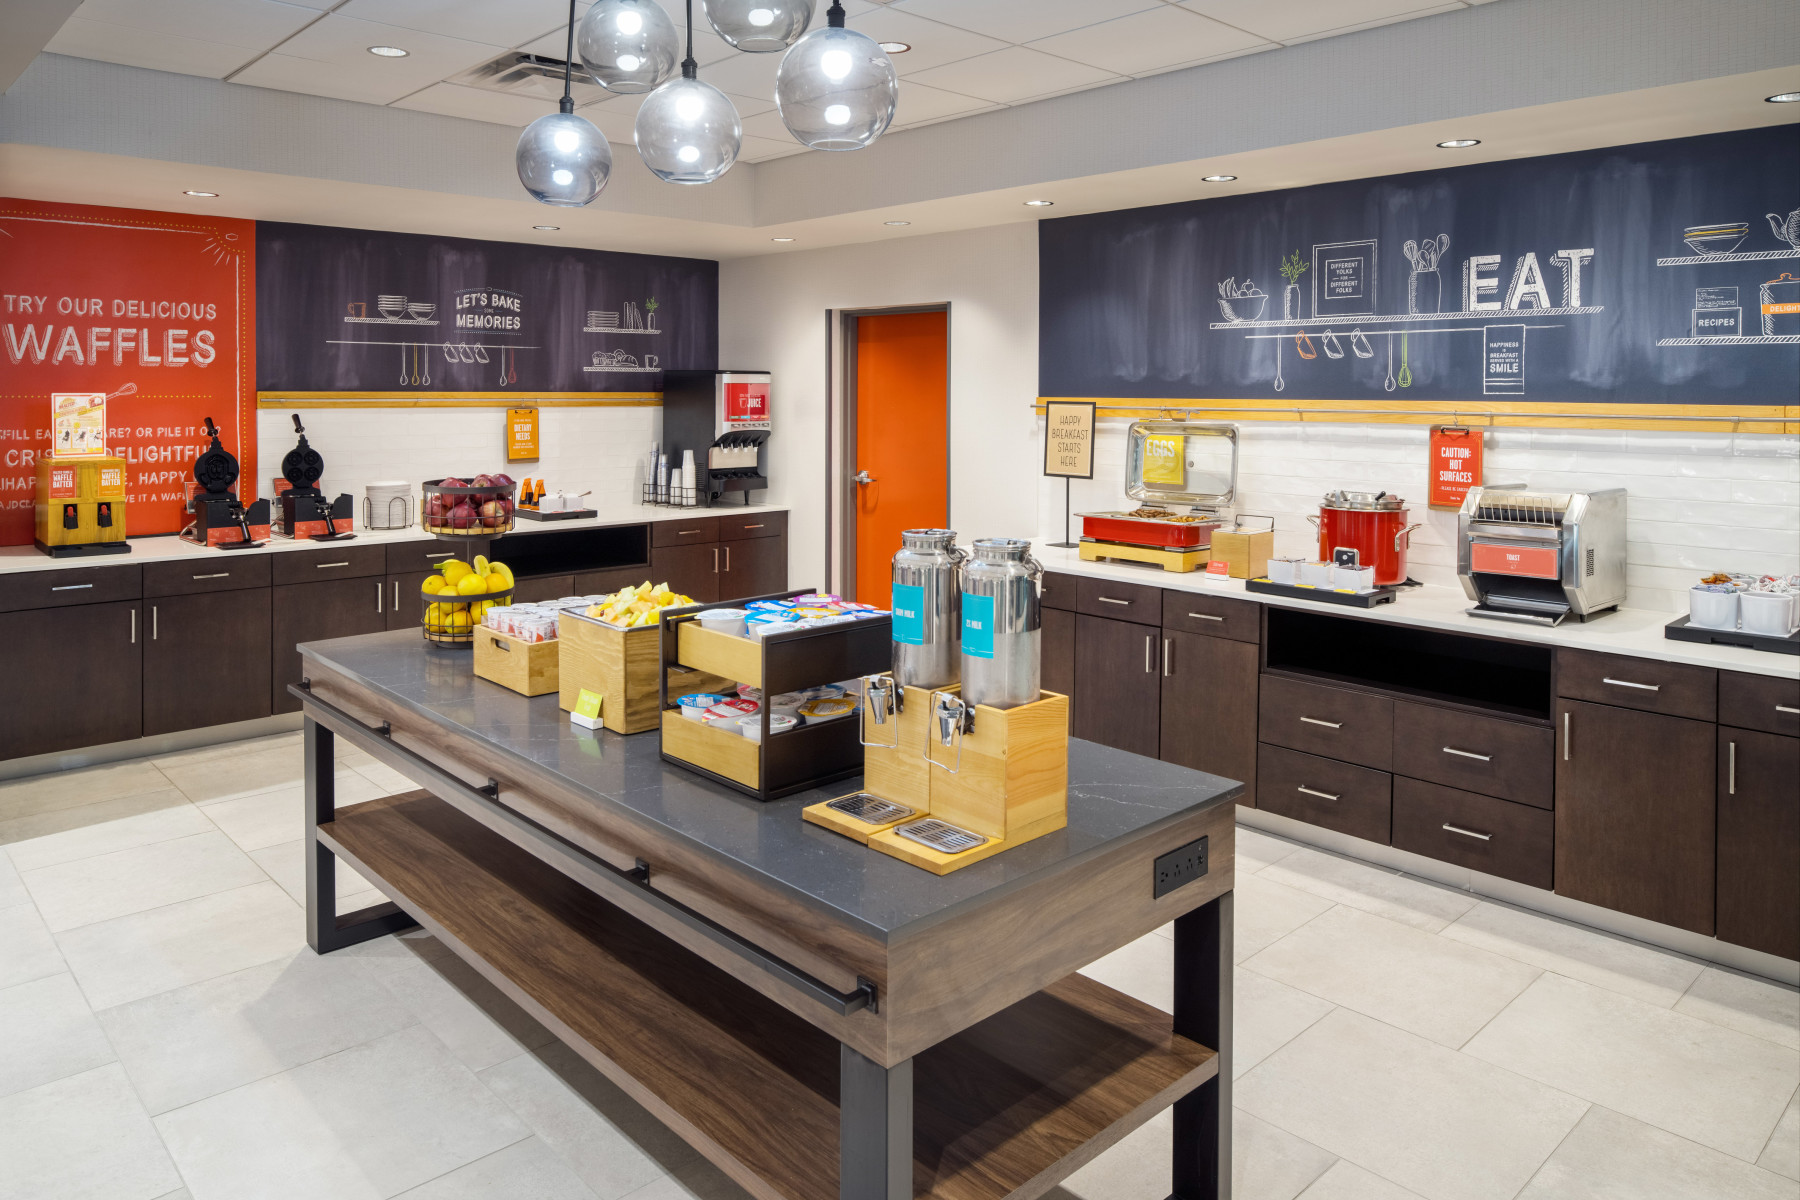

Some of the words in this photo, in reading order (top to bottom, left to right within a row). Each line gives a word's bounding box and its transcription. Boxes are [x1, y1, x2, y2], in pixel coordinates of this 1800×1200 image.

[1330, 261, 1358, 269] DIFFERENT
[1330, 280, 1358, 288] DIFFERENT
[1462, 248, 1594, 313] EAT
[3, 294, 48, 314] TRY
[56, 297, 104, 316] OUR
[111, 299, 218, 321] DELICIOUS
[456, 293, 488, 310] LET'S
[491, 293, 521, 312] BAKE
[456, 314, 521, 330] MEMORIES
[1698, 318, 1735, 328] RECIPES
[2, 323, 217, 368] WAFFLES
[1489, 363, 1519, 373] SMILE
[747, 398, 762, 408] JUICE
[1059, 415, 1082, 426] HAPPY
[136, 427, 153, 438] OR
[157, 426, 182, 438] PILE
[185, 426, 196, 437] IT
[514, 423, 532, 432] DIETARY
[515, 432, 531, 441] NEEDS
[1051, 428, 1089, 440] BREAKFAST
[1057, 441, 1082, 454] STARTS
[1146, 439, 1175, 458] EGGS
[1441, 447, 1471, 459] CAUTION:
[1060, 455, 1078, 468] HERE
[1449, 459, 1463, 470] HOT
[101, 471, 121, 479] WAFFLE
[138, 470, 188, 486] HAPPY
[1439, 470, 1472, 483] SURFACES
[52, 480, 73, 488] BATTER
[101, 479, 121, 487] BATTER
[138, 494, 147, 502] IT
[150, 494, 157, 502] A
[1506, 553, 1520, 561] TOAST
[972, 621, 982, 630] MILK
